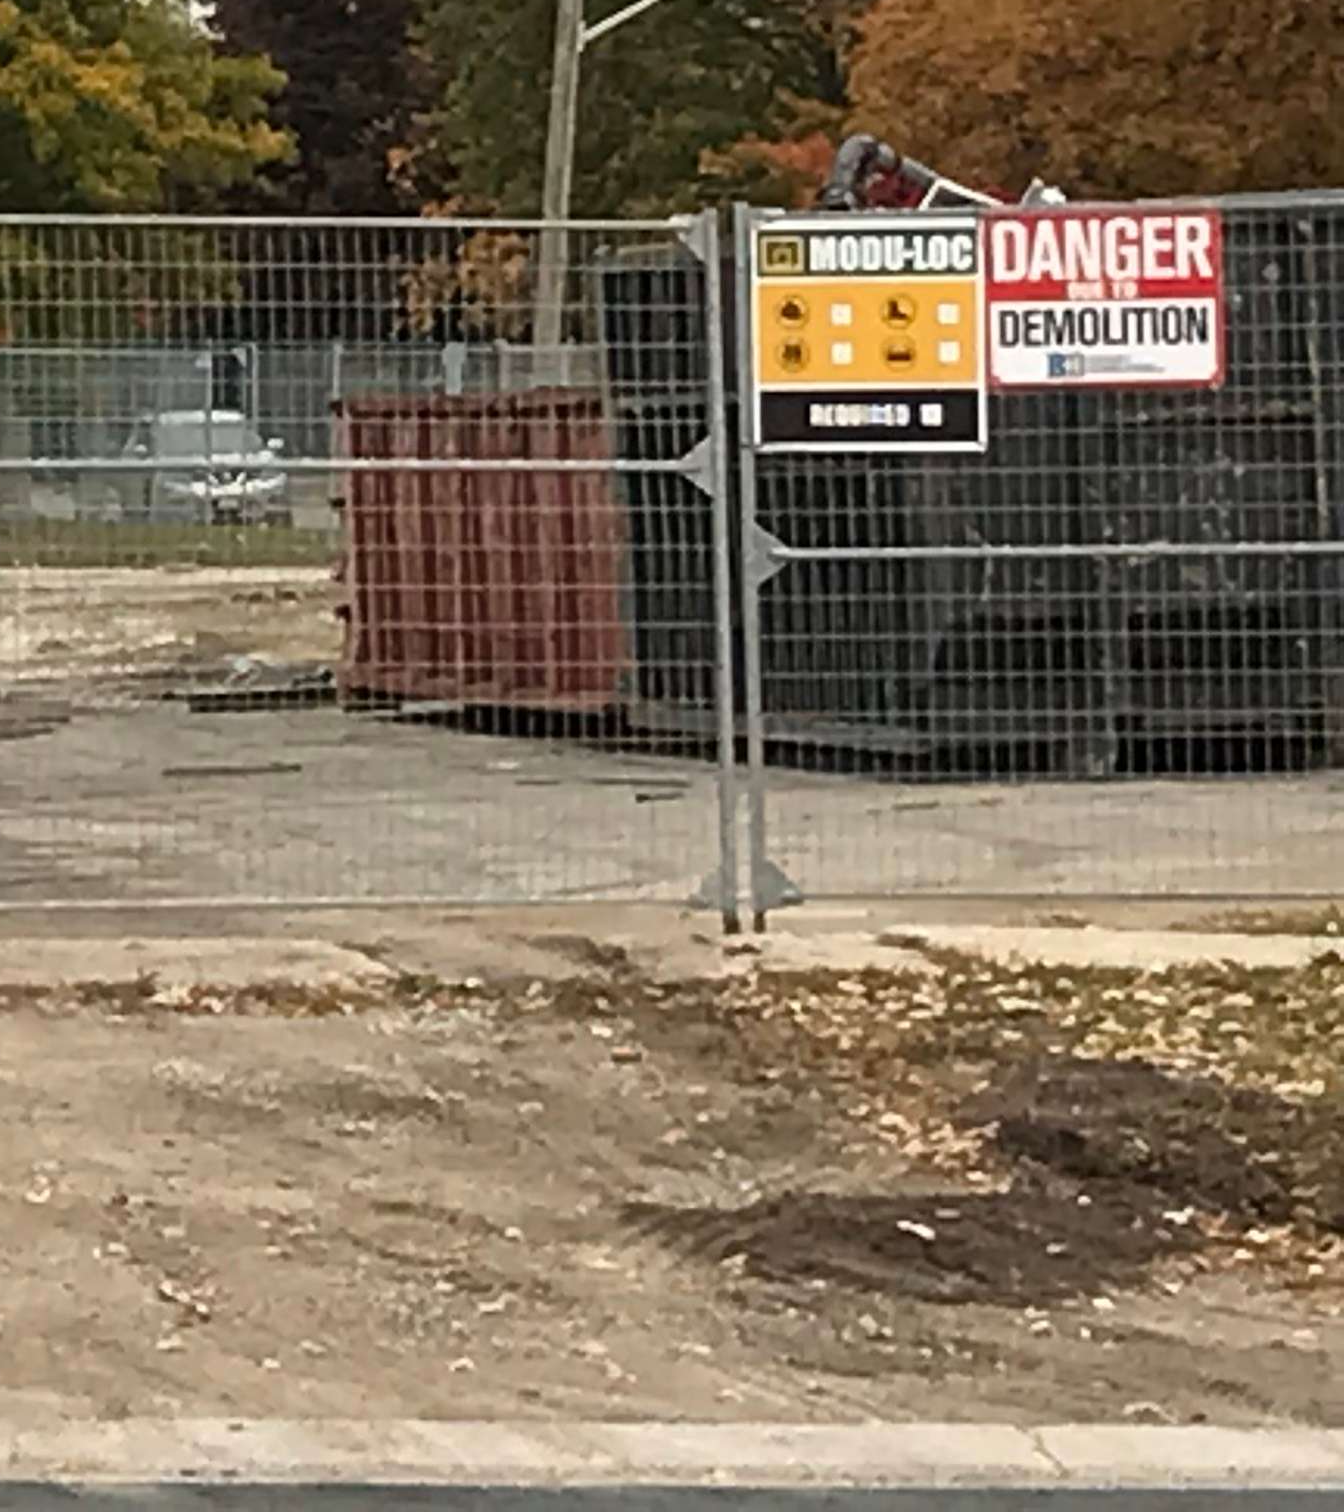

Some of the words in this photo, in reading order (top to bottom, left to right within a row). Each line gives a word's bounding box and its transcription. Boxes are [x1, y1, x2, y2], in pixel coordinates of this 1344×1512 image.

[809, 234, 974, 272] MODU-LOC
[991, 216, 1213, 283] DANGER
[998, 306, 1209, 347] DEMOLITION
